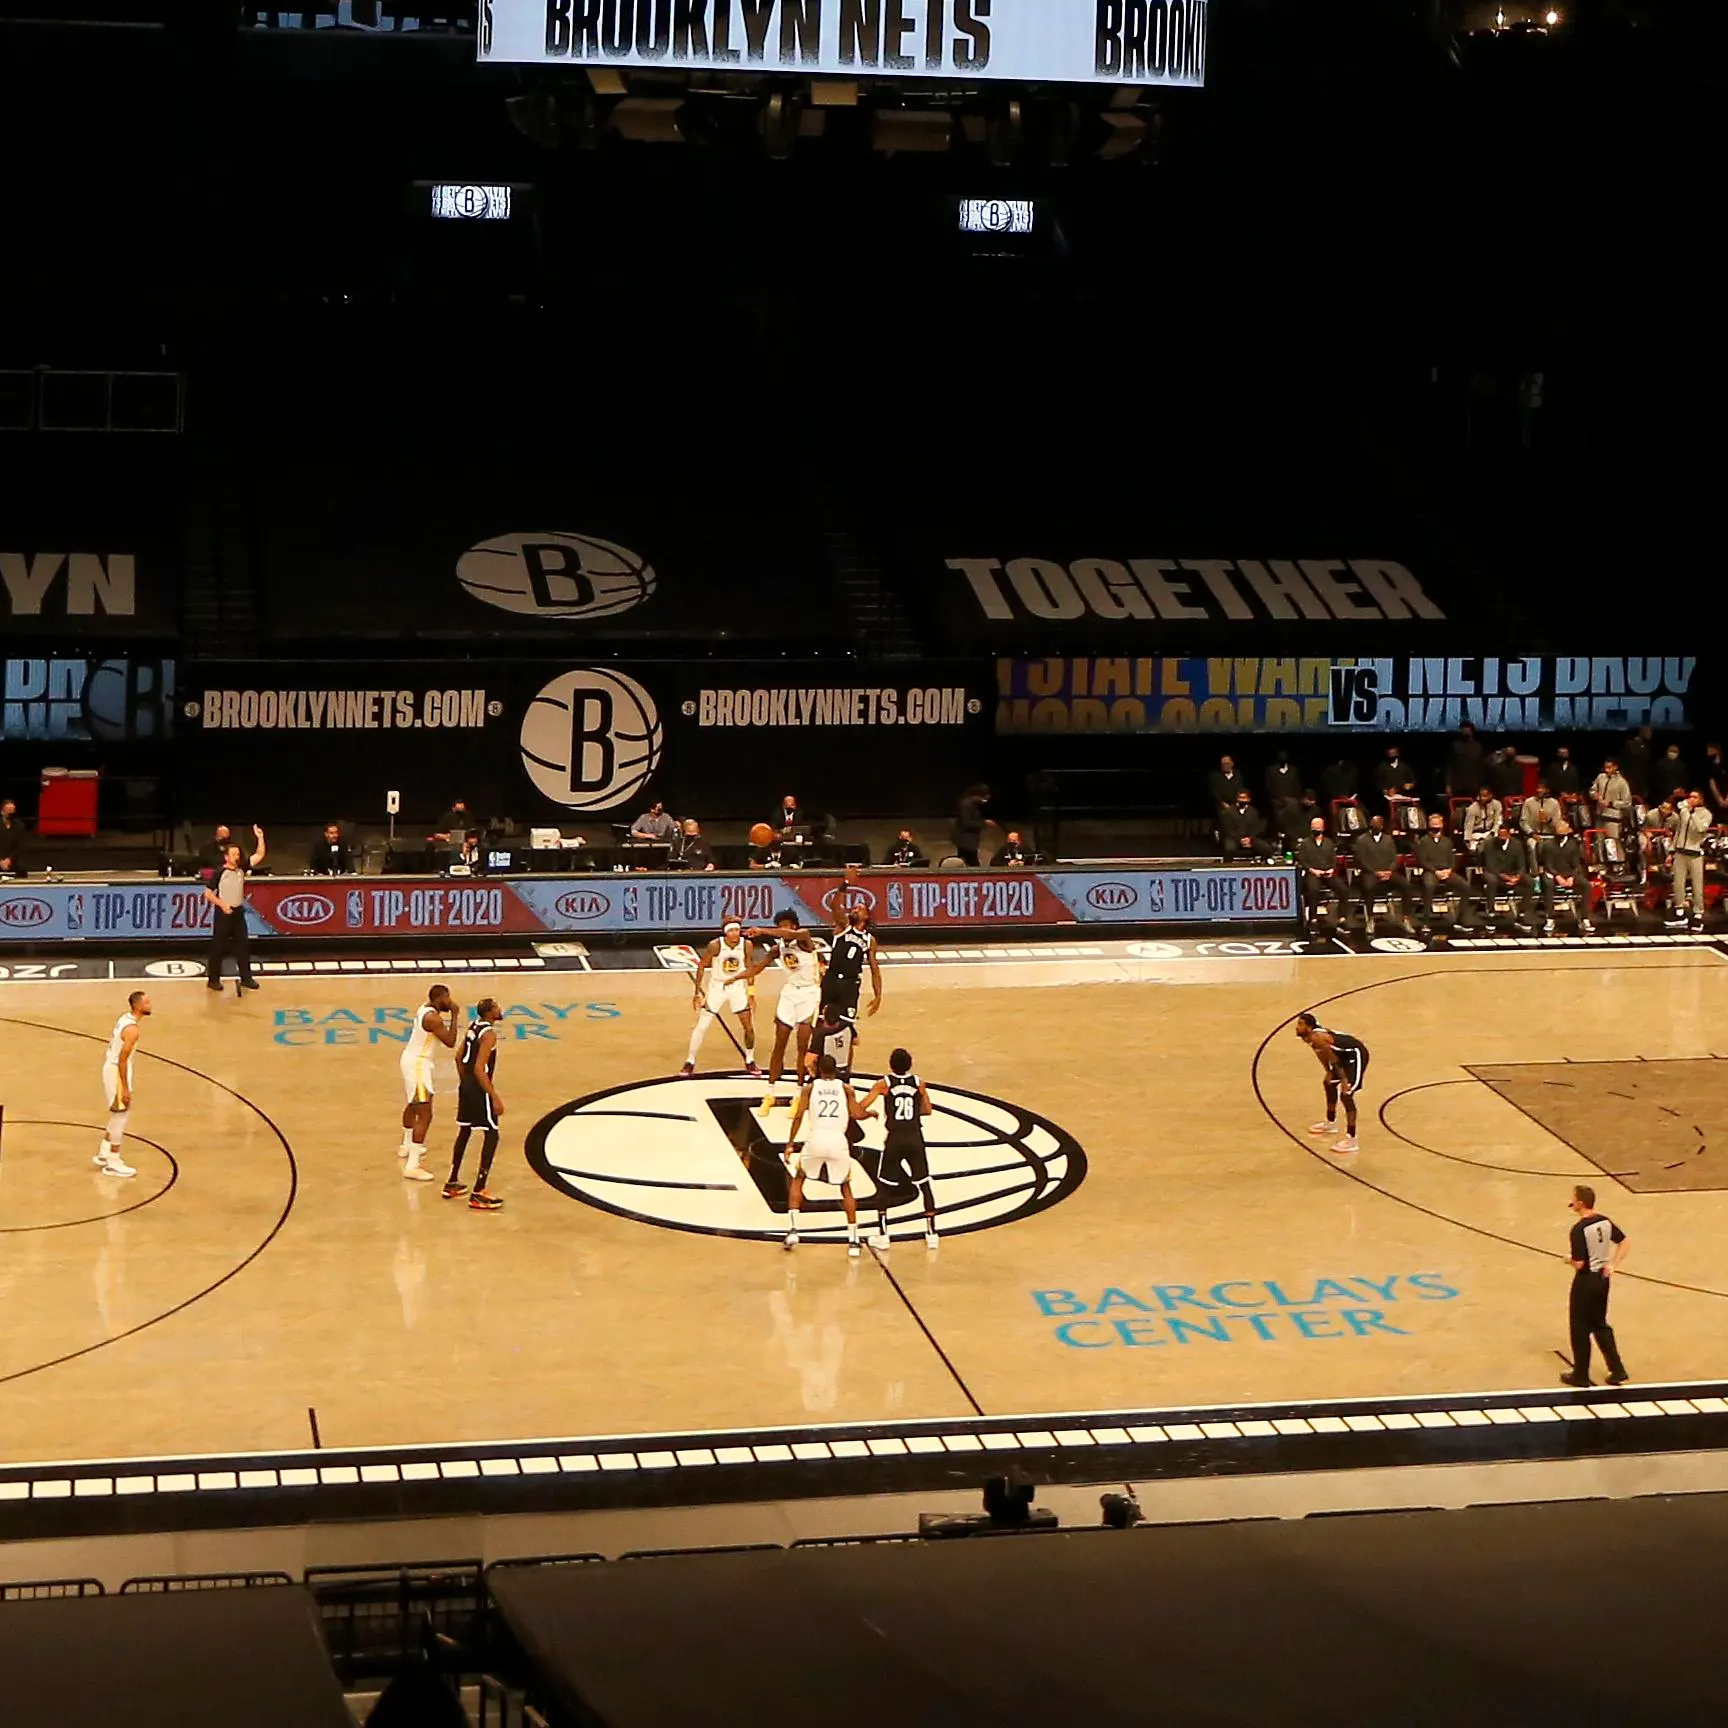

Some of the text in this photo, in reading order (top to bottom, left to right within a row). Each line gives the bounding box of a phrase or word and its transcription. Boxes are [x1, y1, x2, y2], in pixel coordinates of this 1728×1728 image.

[945, 558, 1448, 620] TOGETHER
[203, 690, 485, 728] BROOKLYNNETS.COM
[699, 688, 965, 726] BROOKLYNNETS.COM
[1331, 667, 1378, 724] VS
[570, 688, 616, 793] B
[4, 902, 46, 922] KIA
[172, 894, 214, 929] 202
[284, 900, 328, 919] KIA
[448, 889, 504, 926] 2020
[564, 898, 601, 913] KIA
[721, 884, 772, 920] 2020
[983, 881, 1034, 917] 2020
[1094, 887, 1131, 905] KIA
[1241, 876, 1291, 911] 2020
[817, 1099, 839, 1118] 22
[894, 1097, 914, 1121] 26
[1029, 1272, 1461, 1318] BARCLAYS
[1053, 1308, 1413, 1350] CENTER
